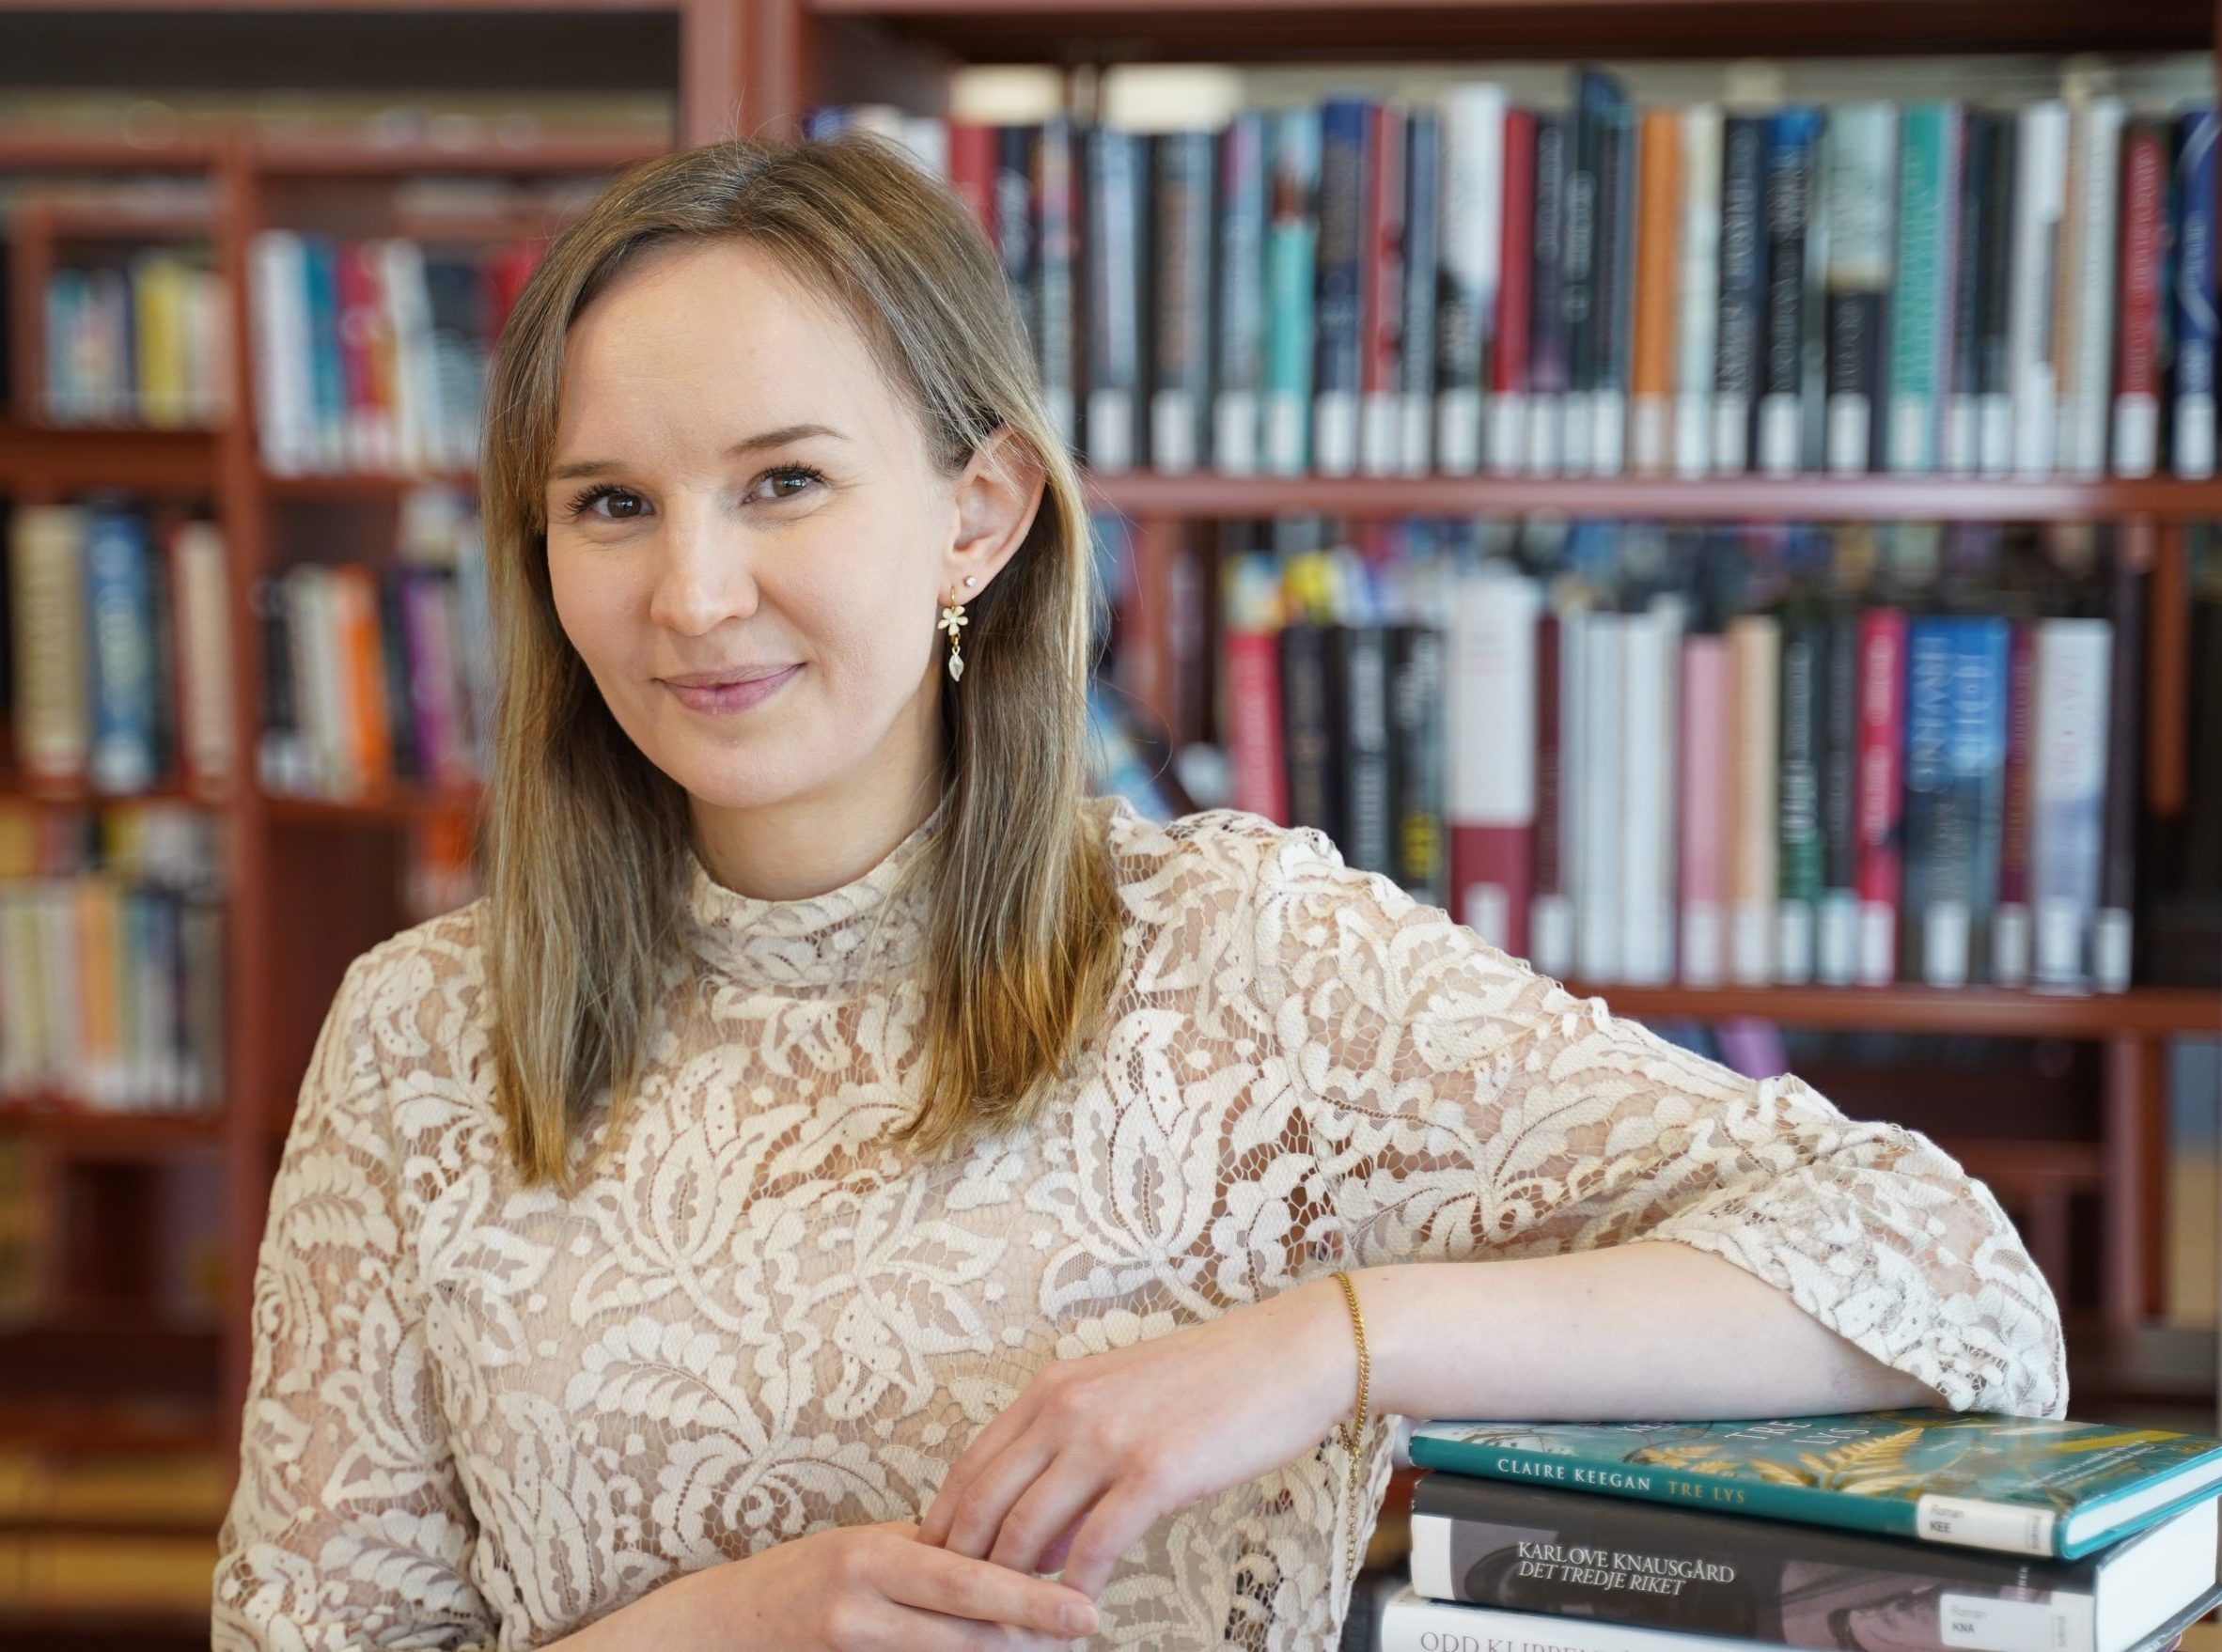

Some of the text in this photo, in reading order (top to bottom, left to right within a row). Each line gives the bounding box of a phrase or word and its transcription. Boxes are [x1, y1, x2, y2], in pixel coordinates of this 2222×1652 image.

[1724, 1421, 1811, 1440] TRE
[1792, 1428, 1869, 1444] LYS
[1496, 1458, 1745, 1504] CLAIRE KEEGAN TRE LYS
[1930, 1520, 1952, 1534] KEE
[1518, 1541, 1735, 1583] KARL OVE KNAUSGÅRD
[1519, 1561, 1686, 1596] DET TREDJE RIKET
[1950, 1605, 1987, 1619] Roman
[1951, 1621, 1976, 1634] KNA
[1420, 1631, 1479, 1652] ODD
